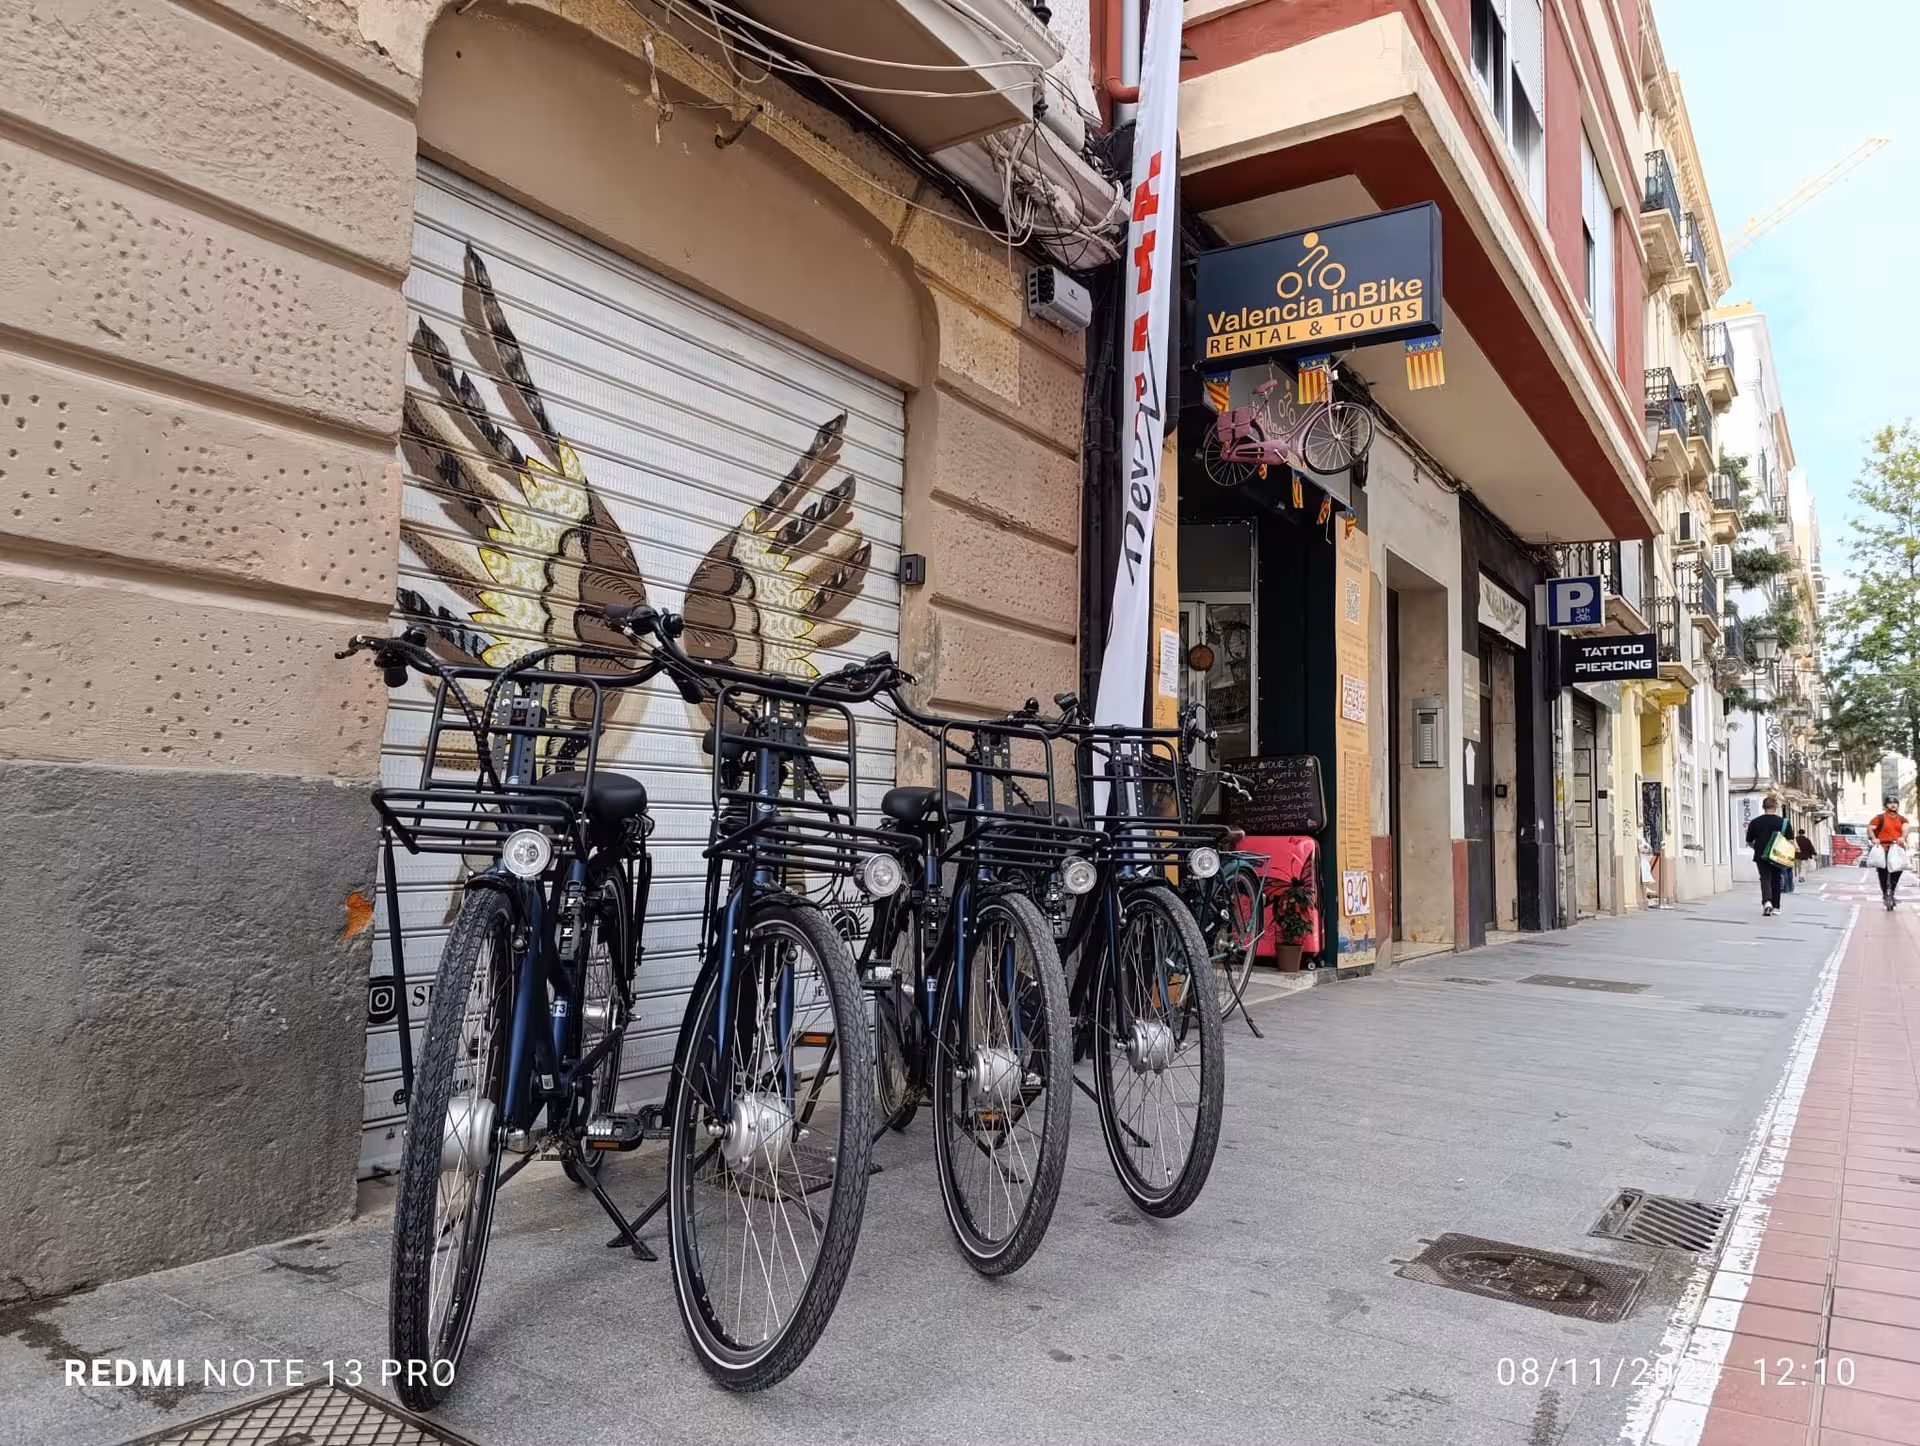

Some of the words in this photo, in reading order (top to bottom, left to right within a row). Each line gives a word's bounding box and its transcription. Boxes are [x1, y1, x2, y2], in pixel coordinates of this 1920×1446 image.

[1208, 296, 1323, 334] Valencia
[1332, 278, 1424, 312] inBike
[1209, 324, 1297, 355] RENTAL
[1309, 320, 1323, 336] &
[1334, 302, 1419, 332] TOURS
[1556, 582, 1594, 624] P
[1582, 644, 1644, 658] TATTOO
[1575, 659, 1652, 673] PIERCING
[1234, 761, 1258, 773] LEAVE
[553, 1003, 566, 1014] T3
